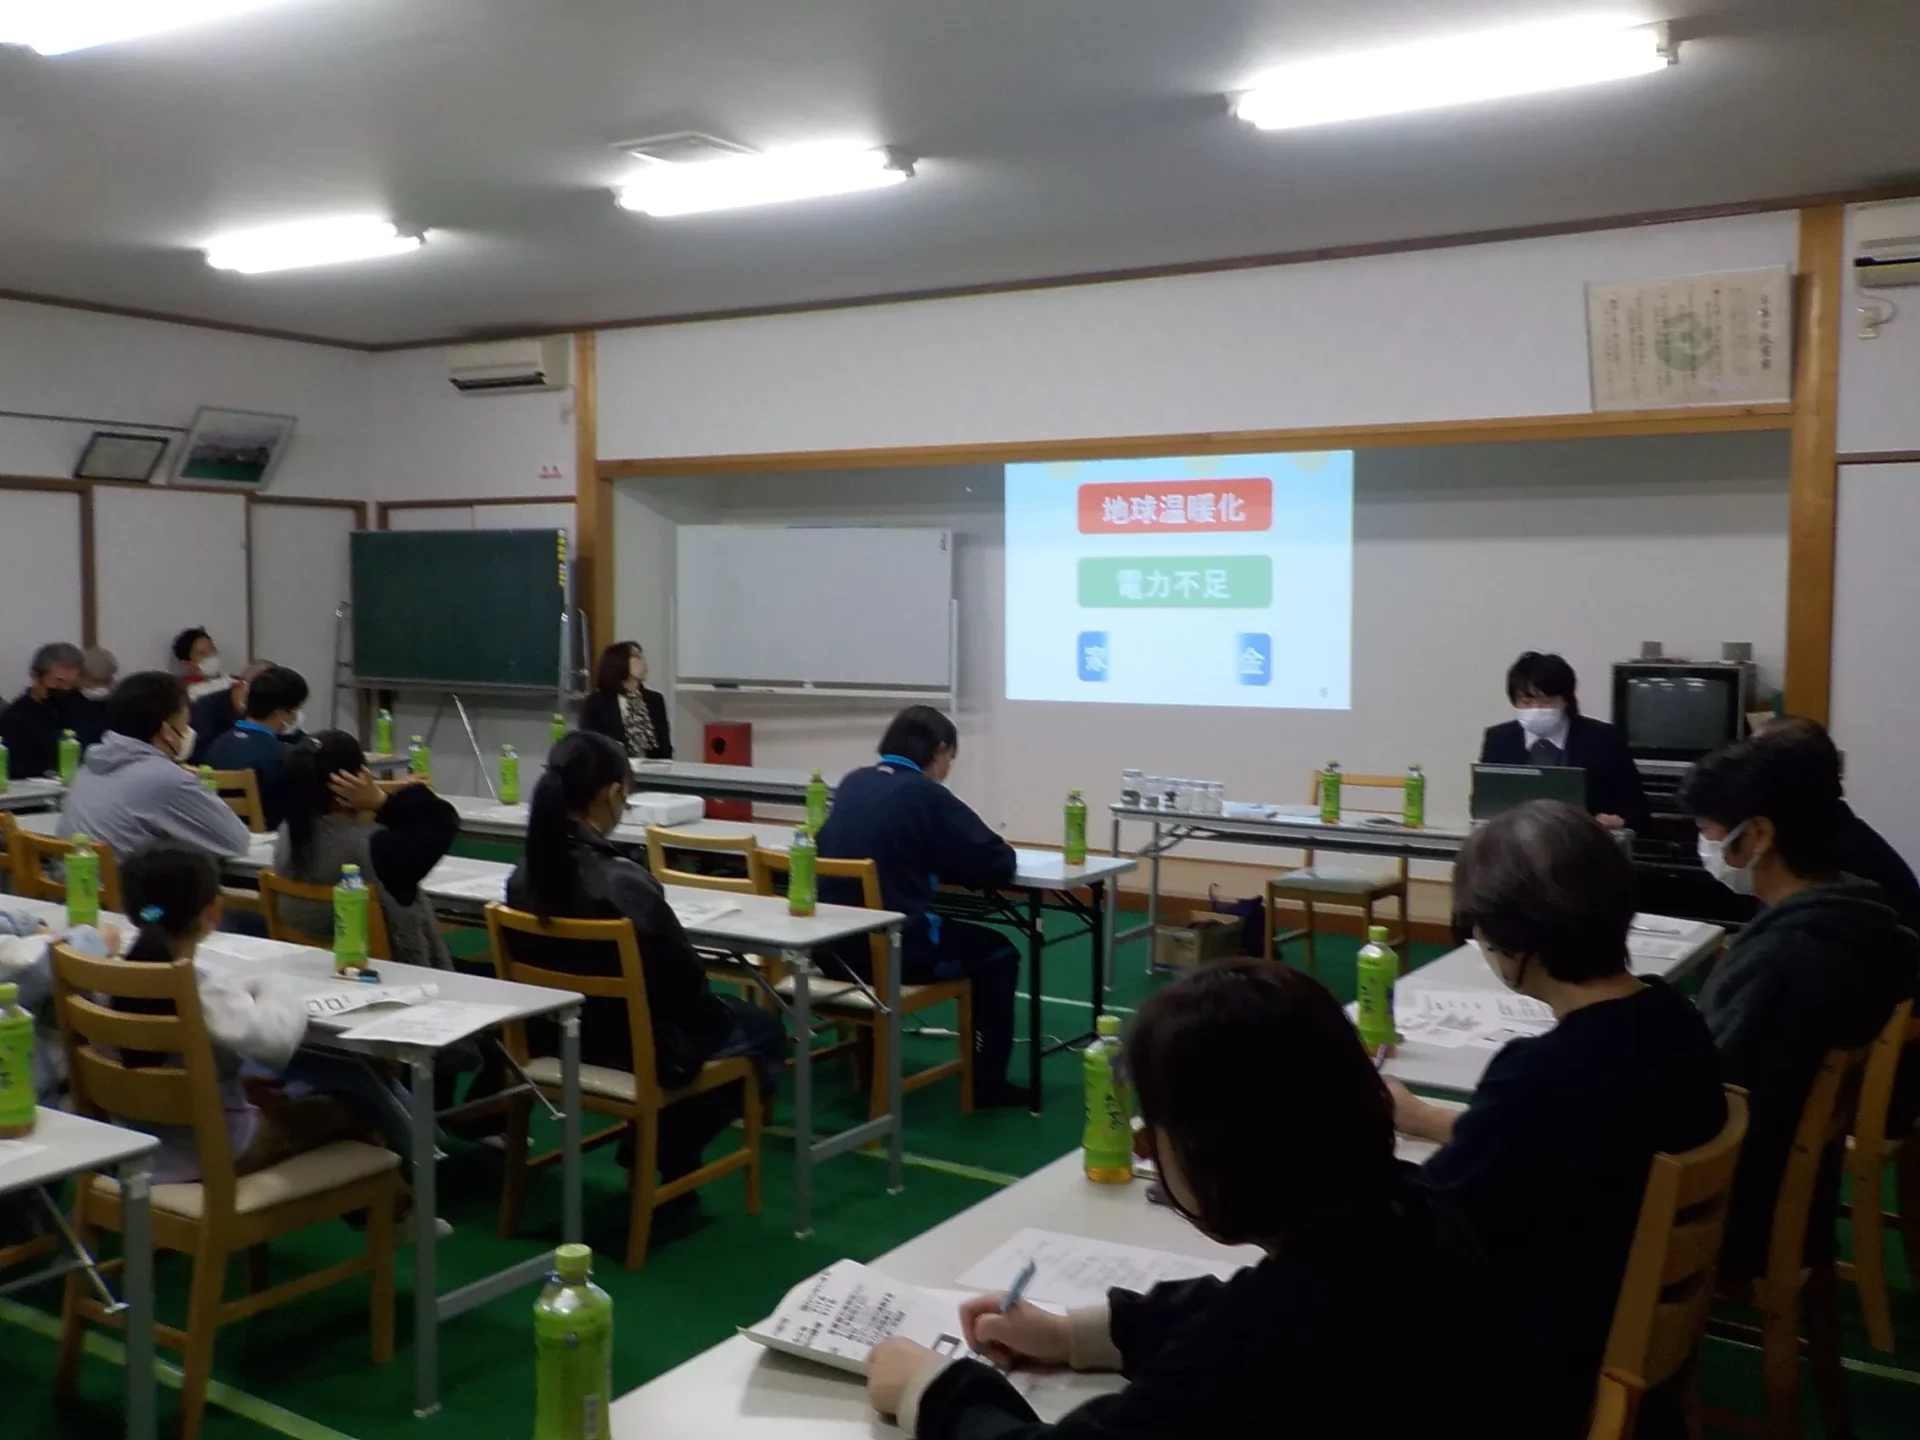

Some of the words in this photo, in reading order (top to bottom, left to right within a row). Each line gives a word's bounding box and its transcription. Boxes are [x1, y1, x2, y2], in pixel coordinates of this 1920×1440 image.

[1102, 493, 1246, 525] 地球温暖化
[1116, 569, 1231, 600] 電力不足
